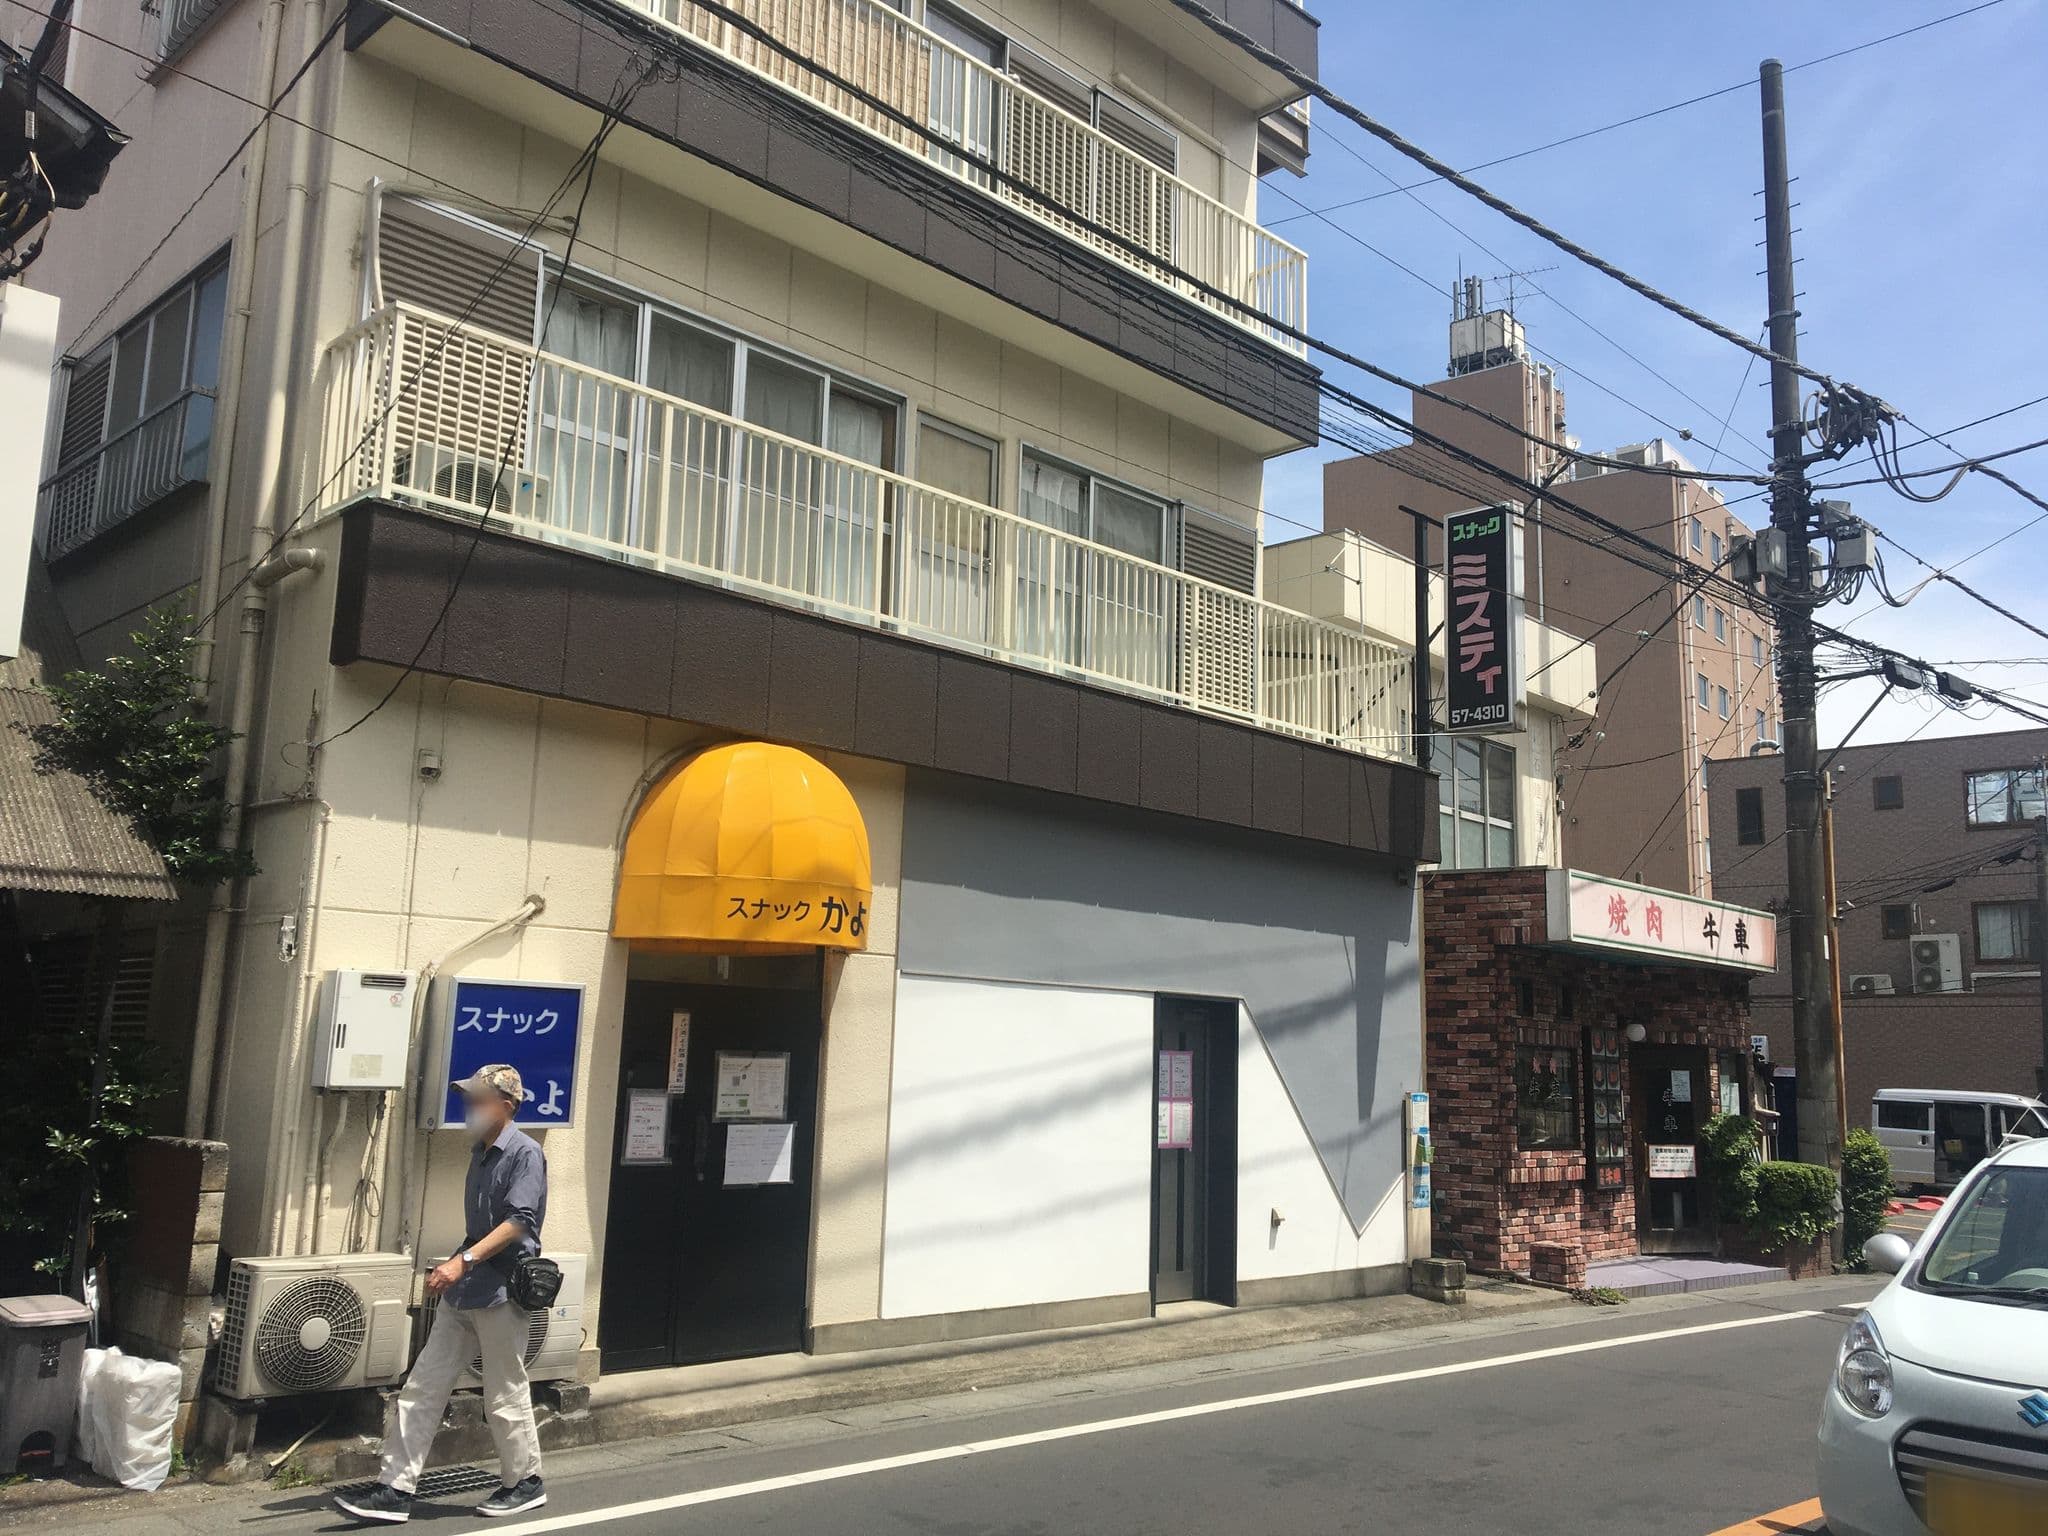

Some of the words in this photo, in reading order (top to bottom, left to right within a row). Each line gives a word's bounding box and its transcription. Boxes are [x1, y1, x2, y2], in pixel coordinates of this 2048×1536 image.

[1453, 516, 1501, 542] スナック
[1452, 553, 1503, 694] ミスティ
[1451, 703, 1505, 725] 57-4310
[727, 897, 811, 922] スナック
[818, 895, 867, 936] かよ
[1607, 892, 1664, 943] 焼肉
[1702, 911, 1750, 956] 牛車
[457, 1006, 559, 1035] スナック
